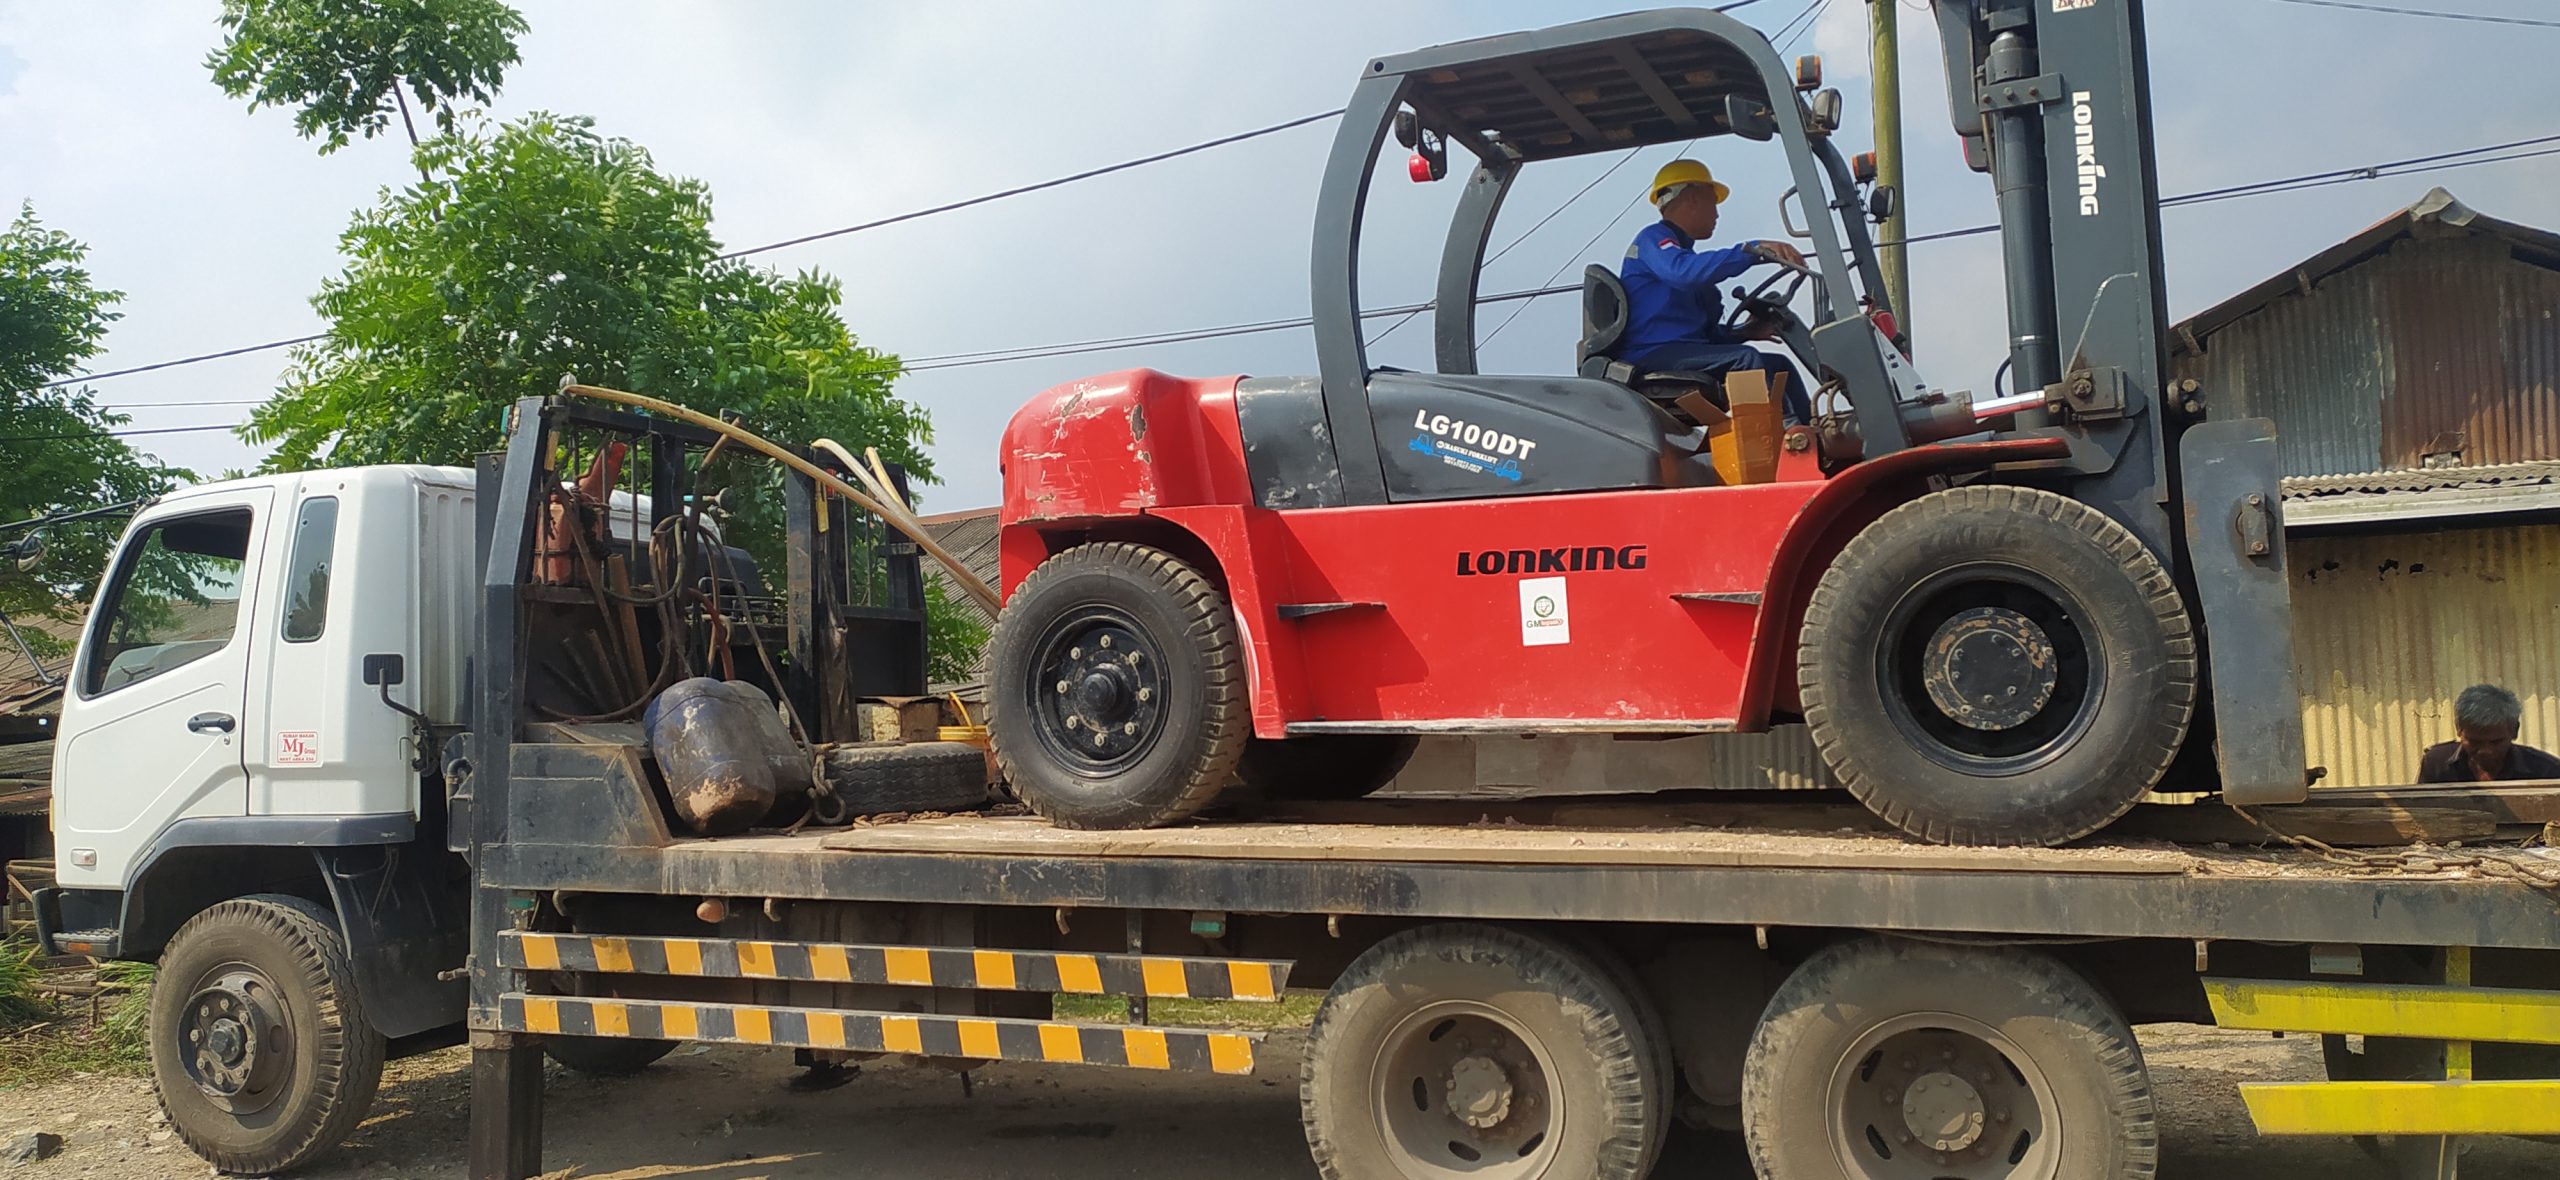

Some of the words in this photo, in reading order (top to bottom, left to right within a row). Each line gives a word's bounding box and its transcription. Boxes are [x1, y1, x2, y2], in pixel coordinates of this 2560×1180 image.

[2072, 91, 2107, 216] LONKING
[1414, 409, 1537, 461] LG100DT
[1457, 545, 1648, 576] LONKING
[282, 738, 304, 757] MJ
